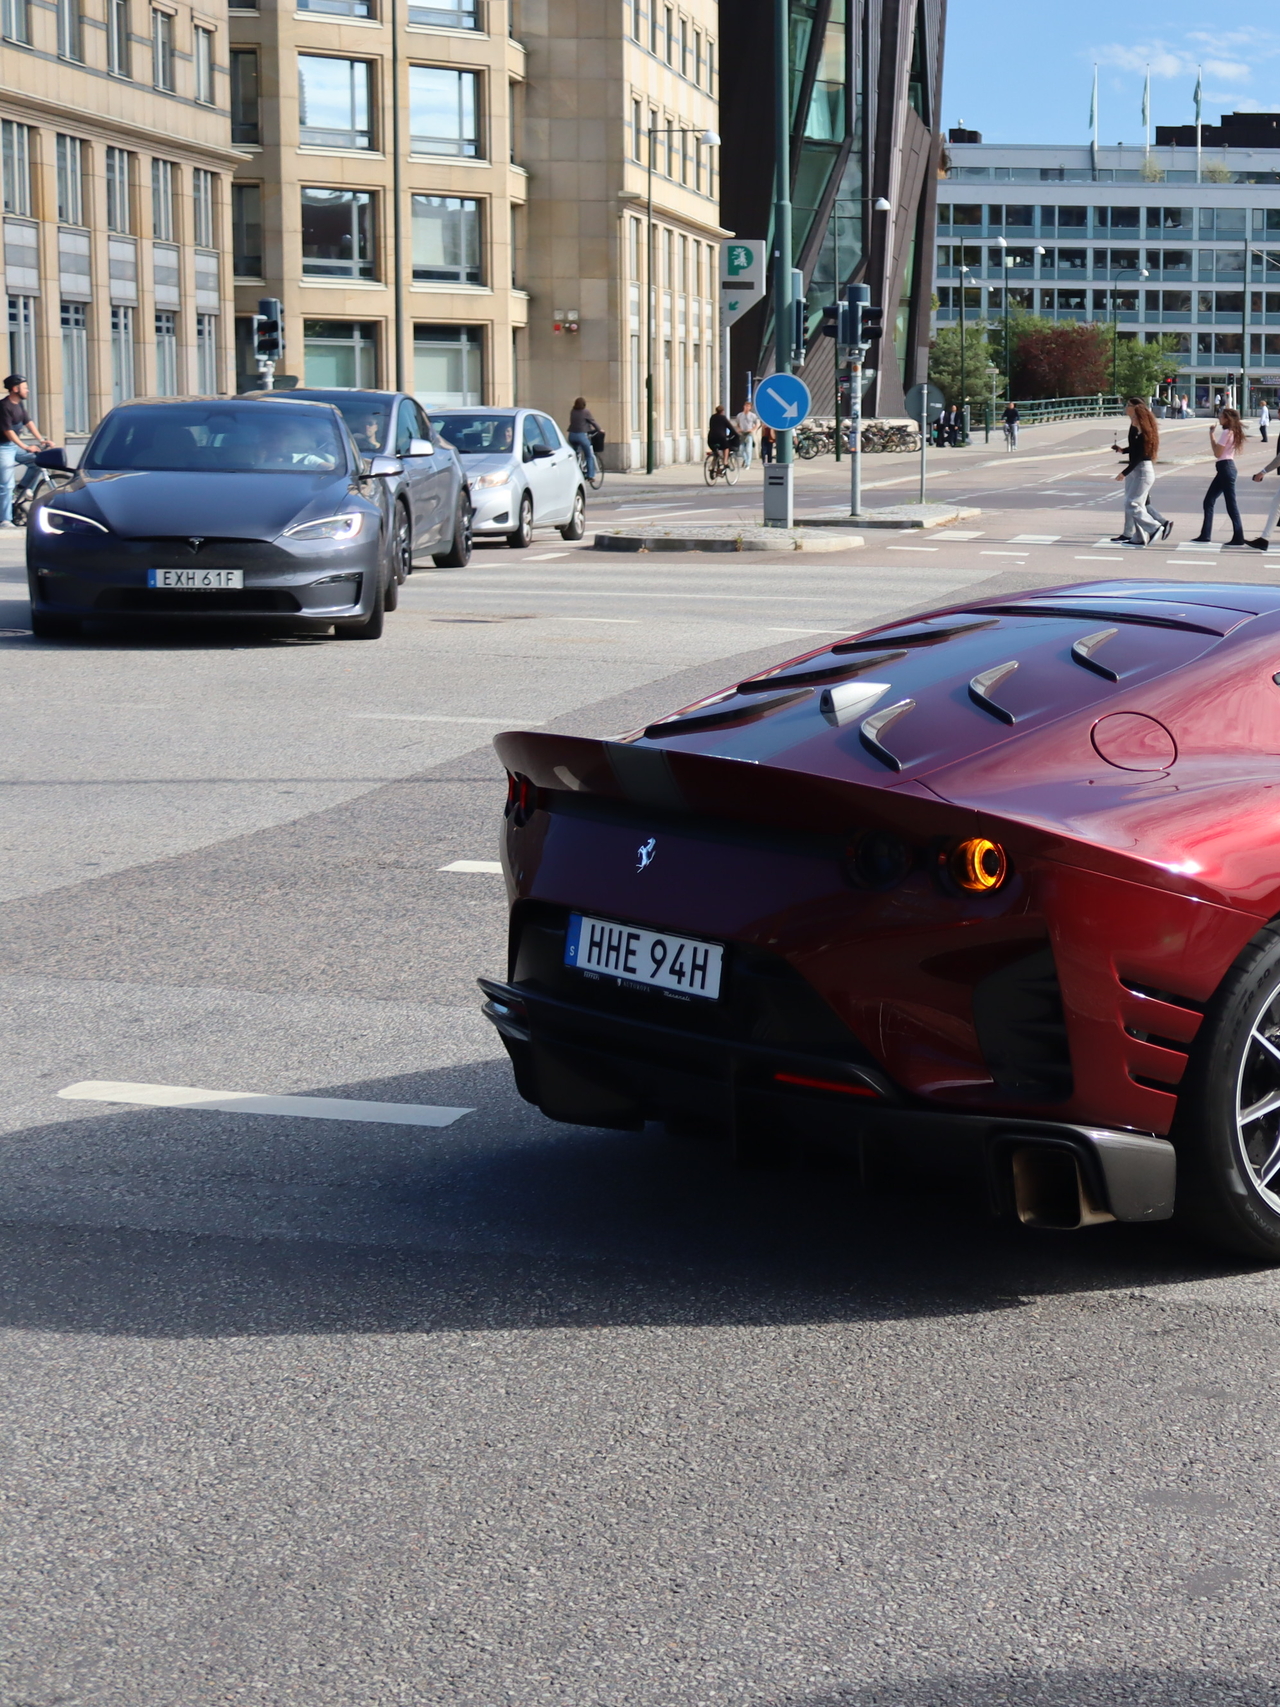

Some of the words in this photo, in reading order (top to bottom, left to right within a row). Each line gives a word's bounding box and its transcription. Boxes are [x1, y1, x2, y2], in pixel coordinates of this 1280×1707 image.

[728, 246, 754, 275] P
[163, 571, 196, 586] EXH
[202, 571, 235, 586] 61F
[569, 945, 575, 956] S
[587, 924, 640, 975] HHE
[650, 939, 709, 990] 94H
